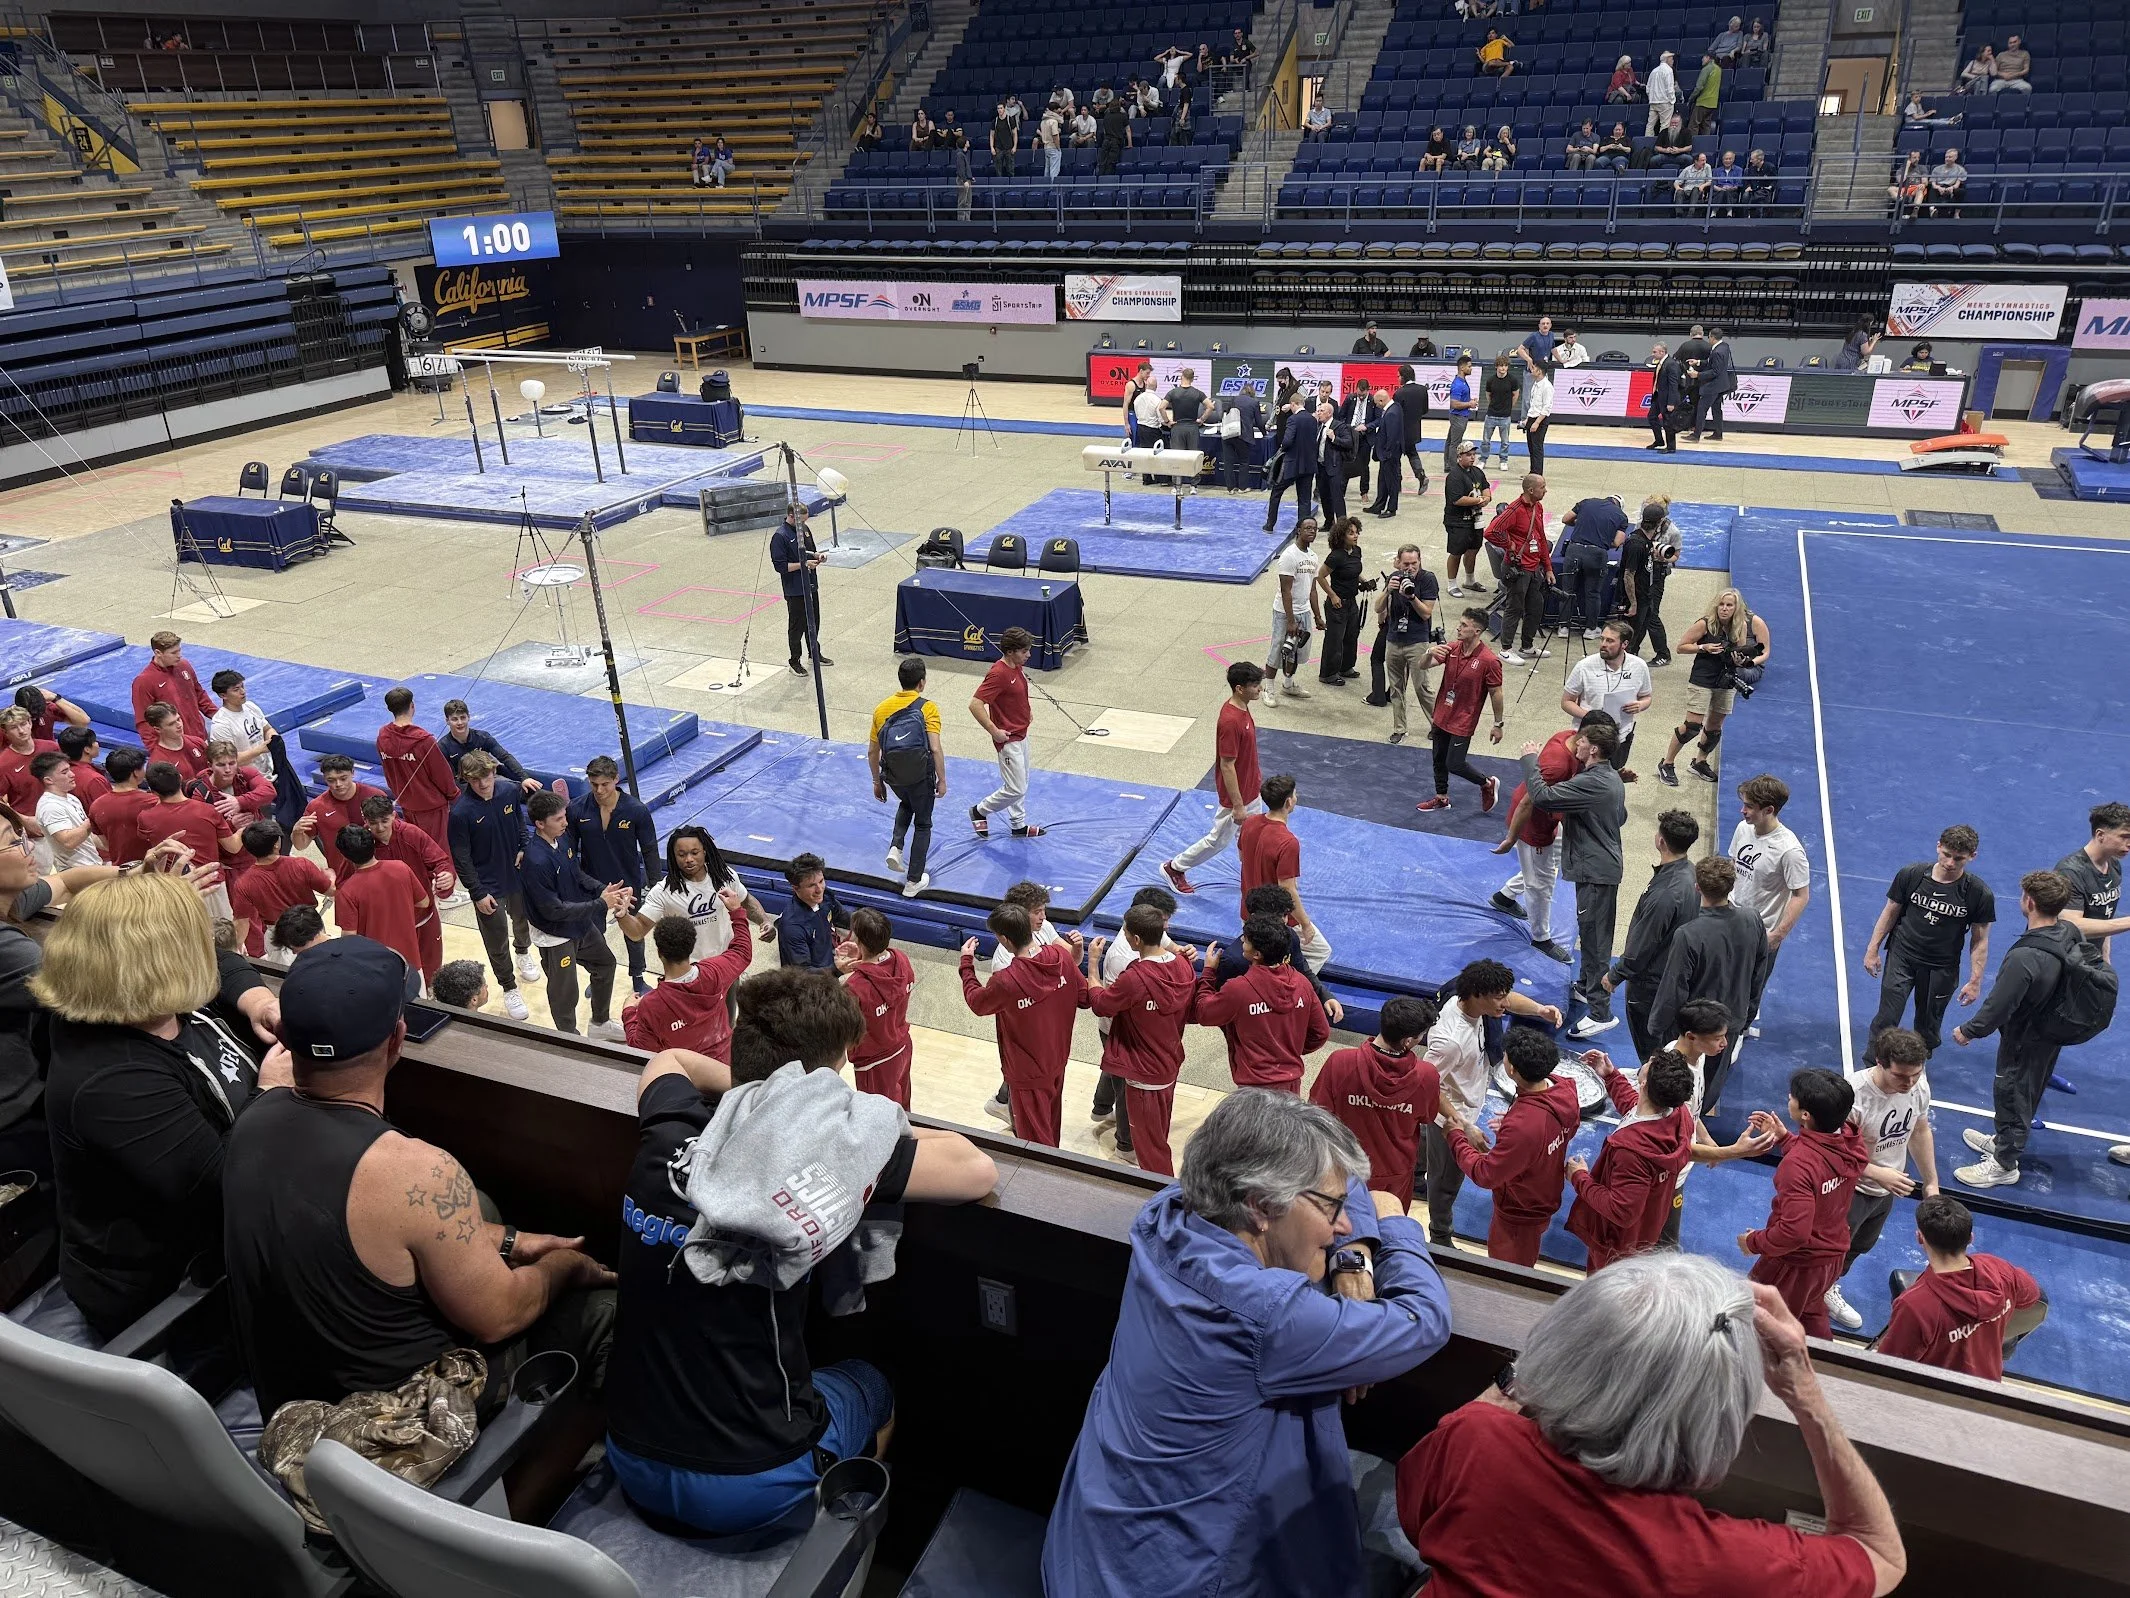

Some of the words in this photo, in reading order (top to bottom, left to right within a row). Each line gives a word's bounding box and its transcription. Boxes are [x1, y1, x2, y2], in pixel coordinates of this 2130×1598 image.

[1857, 10, 1871, 20] EXIT
[78, 136, 89, 150] 24
[463, 222, 531, 256] 1:00
[434, 266, 530, 316] California
[804, 292, 869, 308] MPSF
[1112, 297, 1177, 306] CHAMPIONSHIP
[1896, 306, 1938, 314] MPSF
[1958, 310, 2055, 322] CHAMPIONSHIP
[1568, 387, 1612, 396] MPSF
[1725, 392, 1771, 402] MPSF
[1891, 399, 1942, 409] MPSF
[671, 420, 683, 433] Cal
[249, 464, 259, 473] Cal
[290, 470, 300, 479] Cal
[320, 473, 329, 482] Cal
[639, 502, 648, 514] Cal
[939, 530, 952, 542] Cal
[218, 537, 234, 553] Cal
[1002, 537, 1015, 548] Cal
[1054, 540, 1068, 551] Cal
[964, 624, 985, 644] Cal
[1623, 672, 1632, 680] Cal
[244, 717, 260, 739] Cal
[504, 804, 513, 815] Cal
[618, 820, 631, 829] Cal
[1736, 844, 1762, 871] Cal
[688, 893, 717, 919] Cal
[1924, 912, 1940, 926] AF
[1878, 1108, 1913, 1143] Cal
